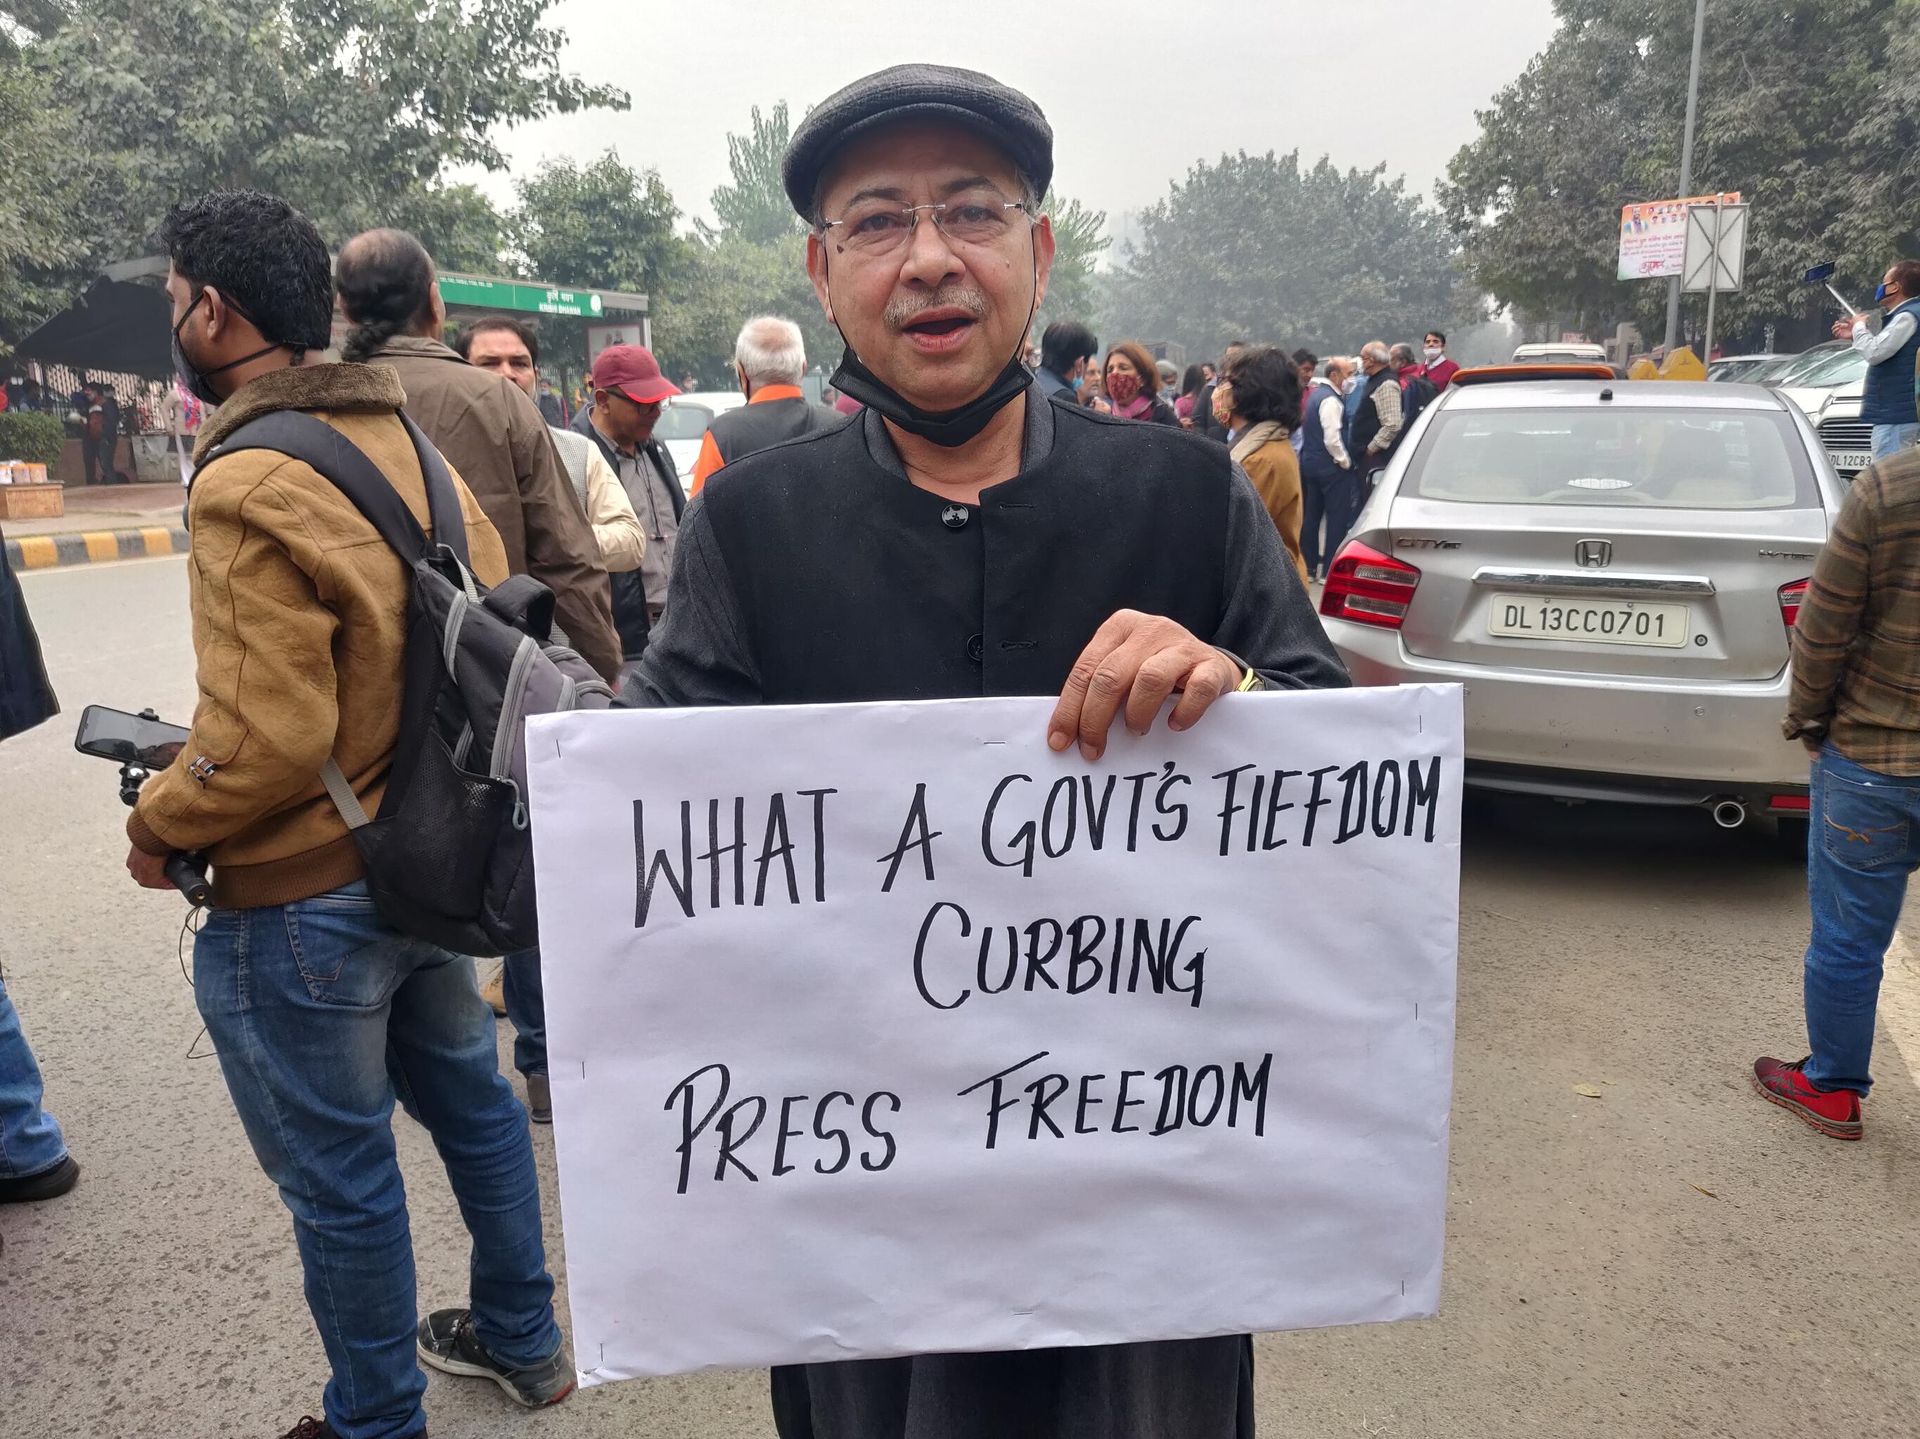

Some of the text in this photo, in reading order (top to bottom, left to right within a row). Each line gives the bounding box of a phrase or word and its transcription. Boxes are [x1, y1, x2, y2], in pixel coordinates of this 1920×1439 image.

[633, 788, 838, 929] WHAT
[877, 783, 943, 893] A
[1210, 756, 1442, 857] FIEFDOM
[914, 902, 1208, 1010] CURBING
[664, 1051, 1273, 1194] PRESS FREEDOM
